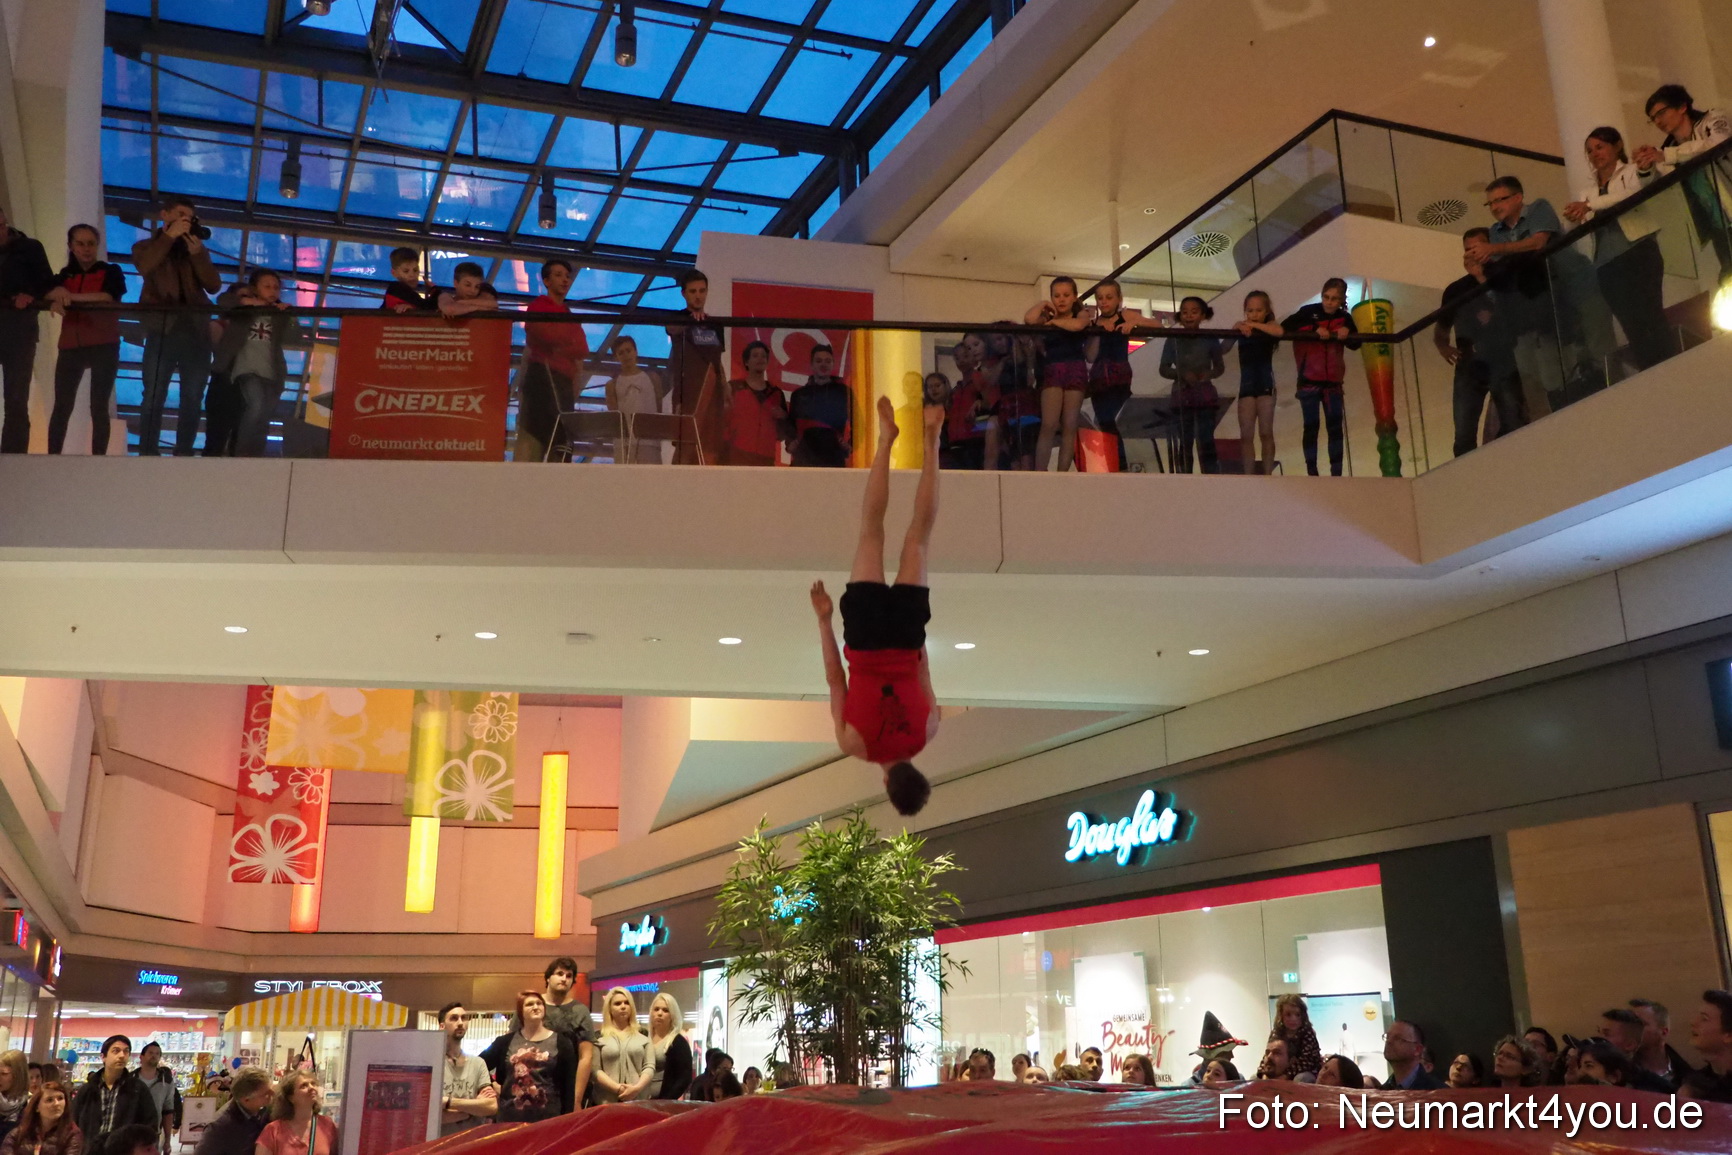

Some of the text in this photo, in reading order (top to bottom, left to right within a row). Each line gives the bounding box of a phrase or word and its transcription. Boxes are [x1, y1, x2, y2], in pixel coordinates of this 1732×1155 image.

[375, 346, 474, 362] NeuerMarkt
[354, 389, 486, 414] CINEPLEX
[1065, 789, 1178, 867] Douglas
